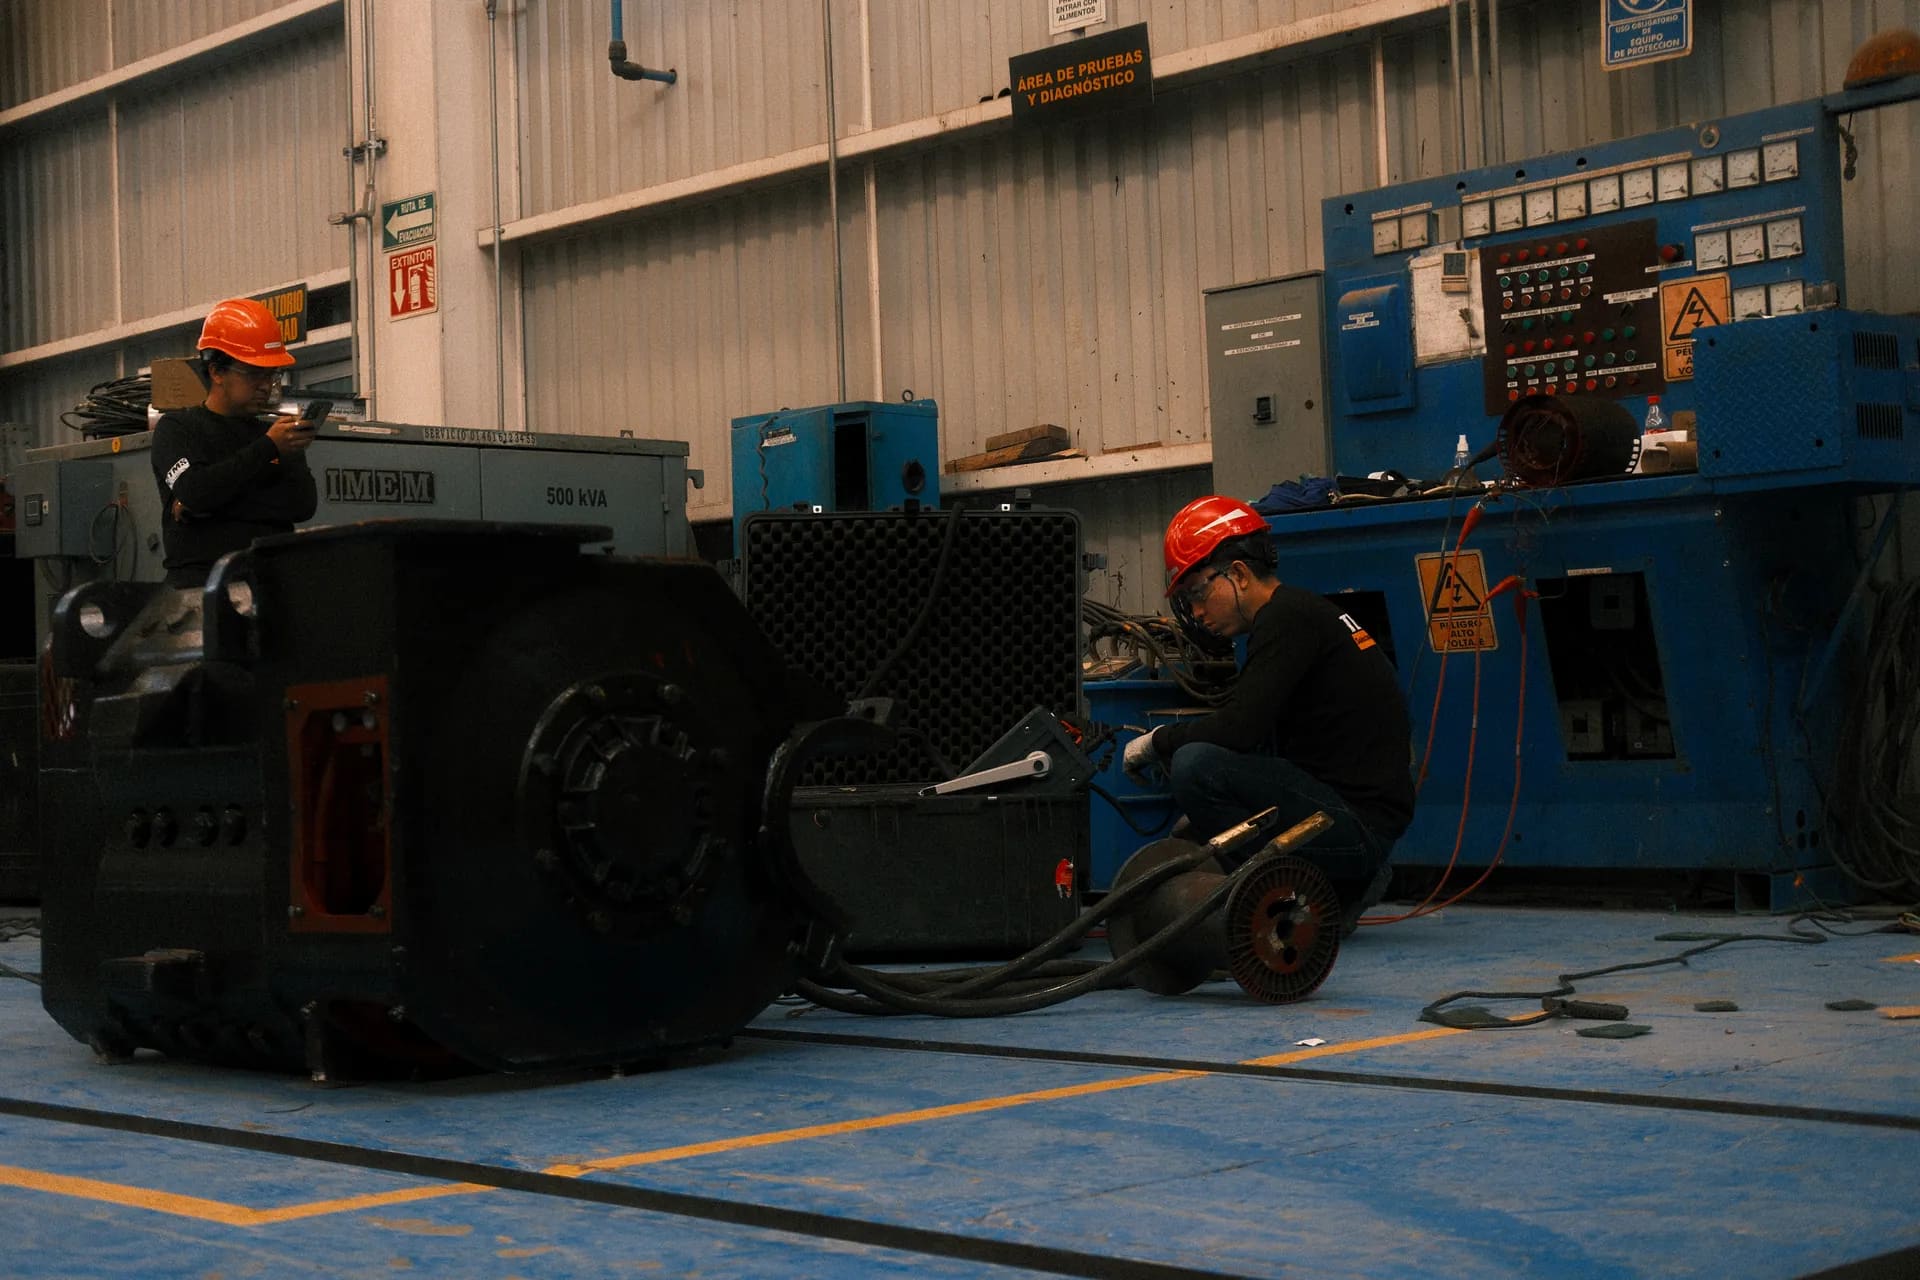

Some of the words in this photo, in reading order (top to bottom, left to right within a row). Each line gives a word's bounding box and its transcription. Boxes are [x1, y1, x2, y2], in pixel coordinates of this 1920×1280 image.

[1056, 2, 1082, 14] ENTRAR
[1058, 6, 1096, 21] ALIMENTOS
[1615, 25, 1630, 33] USO
[1631, 14, 1679, 30] OBLIGATORIO
[1642, 27, 1651, 35] DE
[1630, 33, 1664, 47] EQUIPO
[1614, 49, 1626, 59] DE
[1627, 38, 1680, 57] PROTECCION
[1017, 72, 1053, 93] ÁREA
[1056, 66, 1075, 83] DE
[1078, 49, 1144, 77] PRUEBAS
[1027, 92, 1037, 108] Y
[1039, 69, 1136, 105] DIAGNÓSTICO
[401, 201, 416, 213] RUTA
[418, 198, 427, 209] DE
[391, 249, 433, 270] EXTINTOR
[424, 428, 466, 441] SERVICIO
[326, 468, 435, 504] IMEM
[547, 487, 573, 506] 500
[579, 489, 608, 507] kVA
[1450, 630, 1474, 638] ALTO
[1446, 638, 1485, 647] OLTAE
